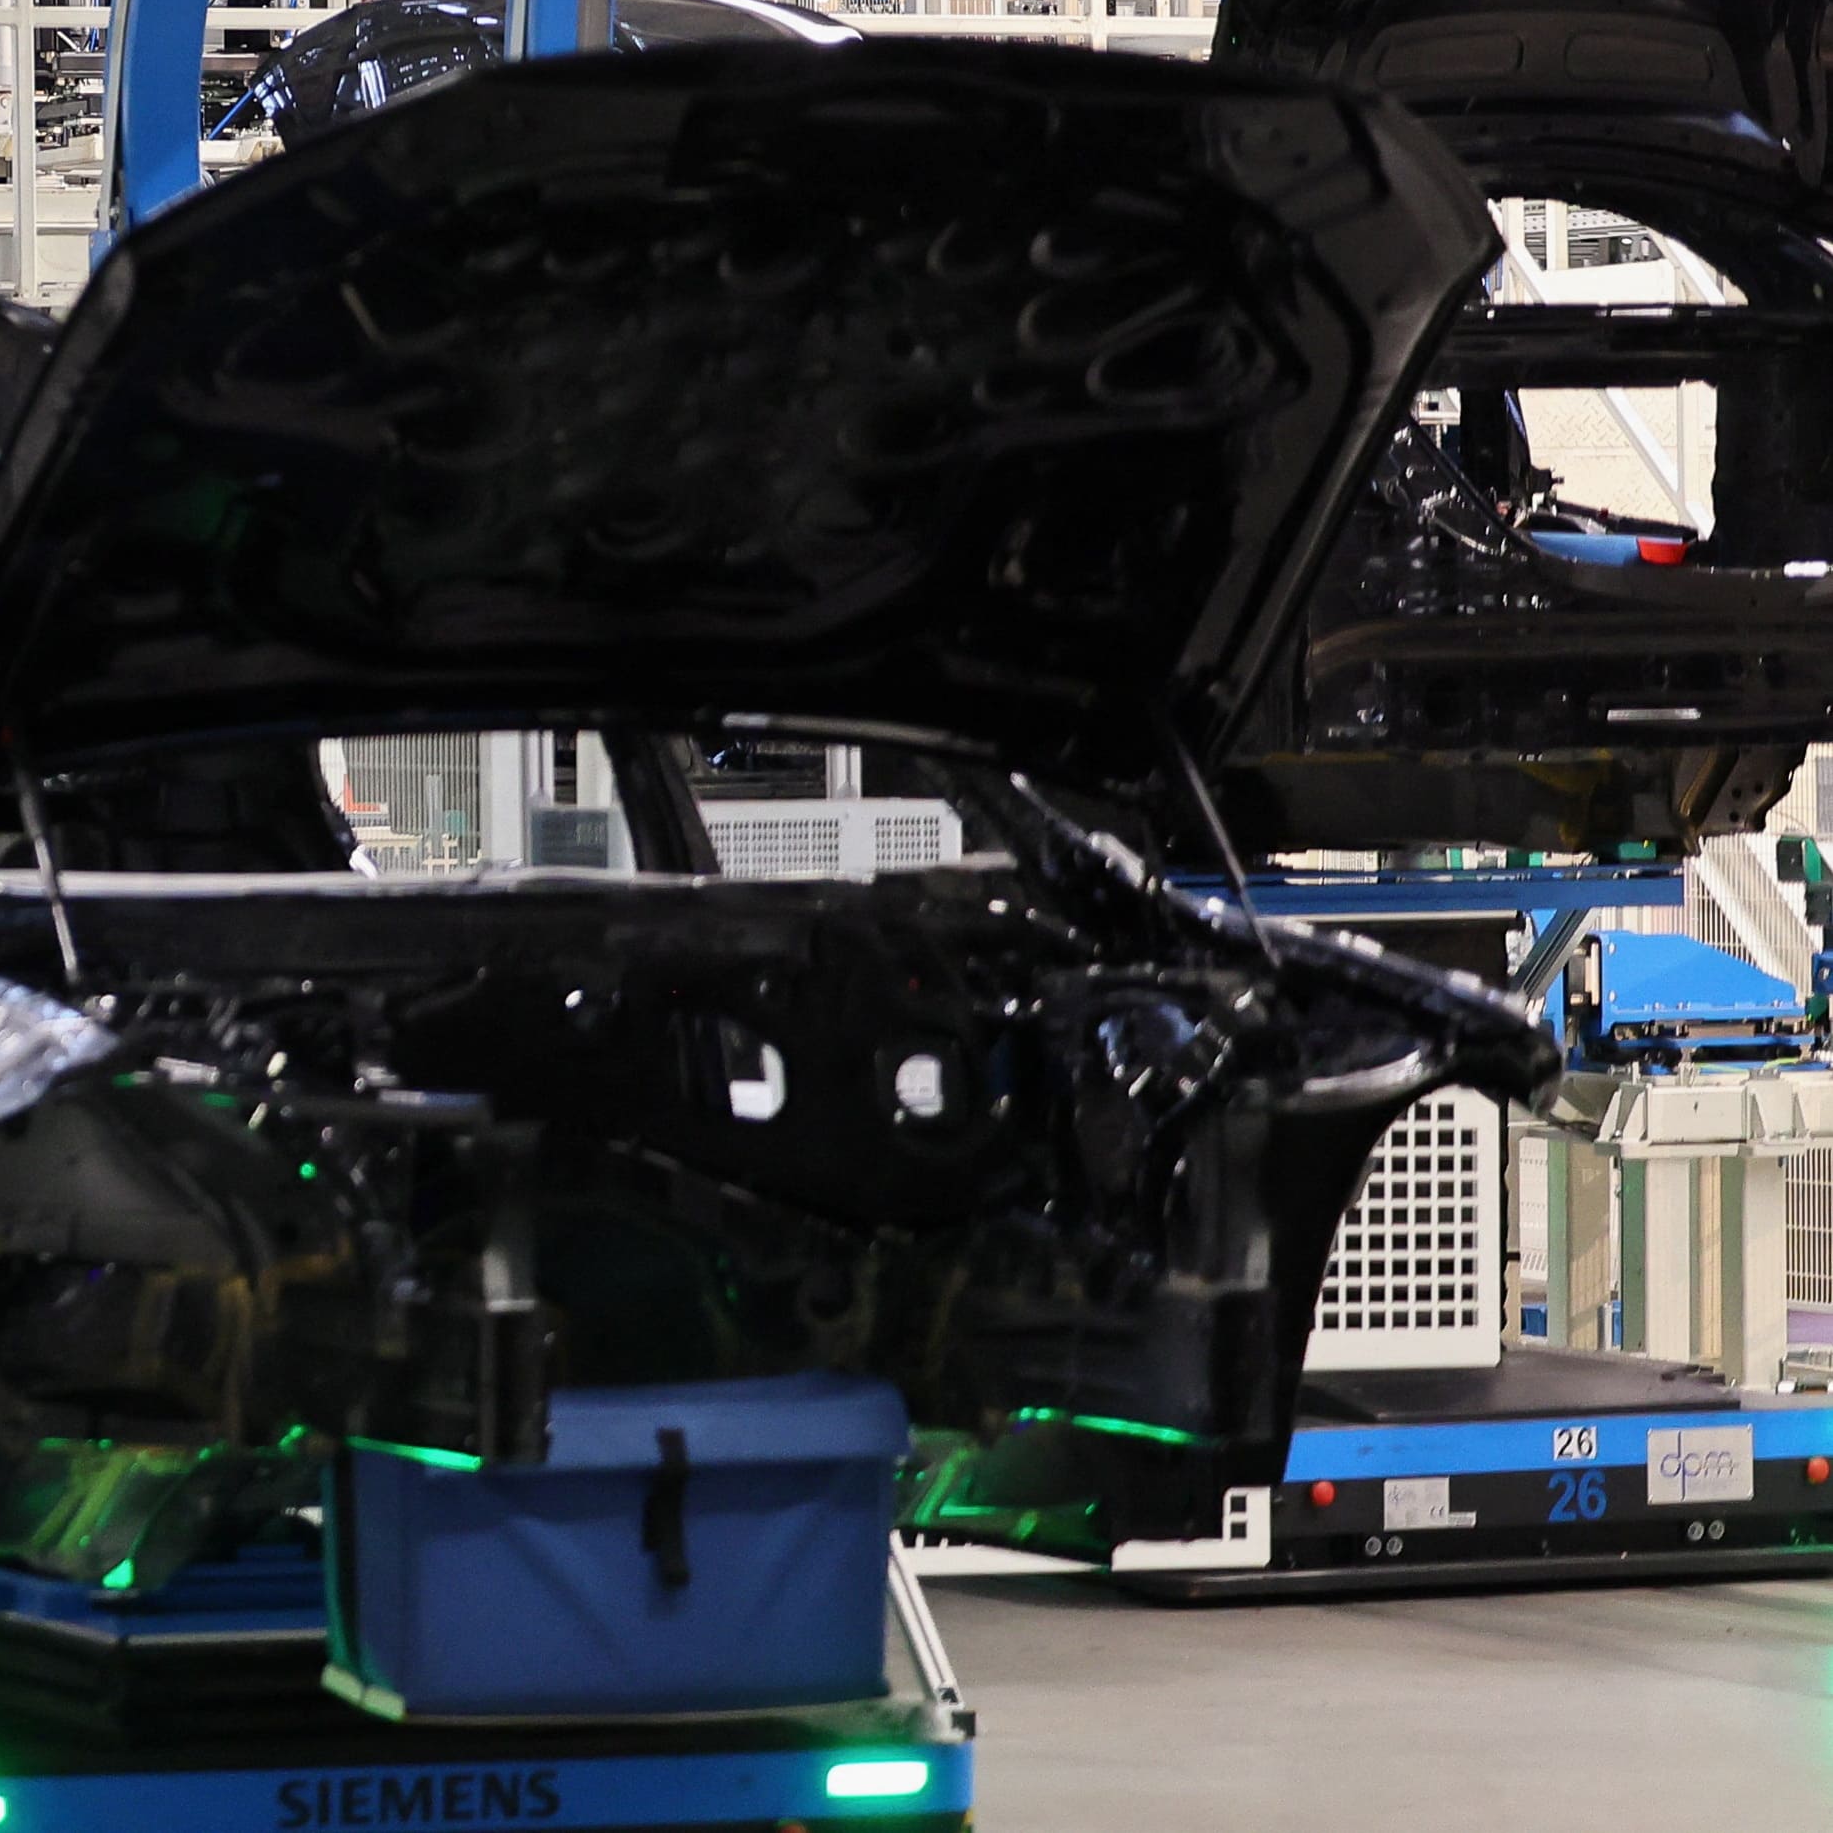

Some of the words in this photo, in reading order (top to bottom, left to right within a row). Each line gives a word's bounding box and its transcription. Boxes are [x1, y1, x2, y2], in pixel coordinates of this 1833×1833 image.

[1556, 1427, 1594, 1459] 26
[1659, 1430, 1738, 1502] dpm
[1548, 1468, 1608, 1523] 26
[276, 1769, 562, 1829] SIEMENS
